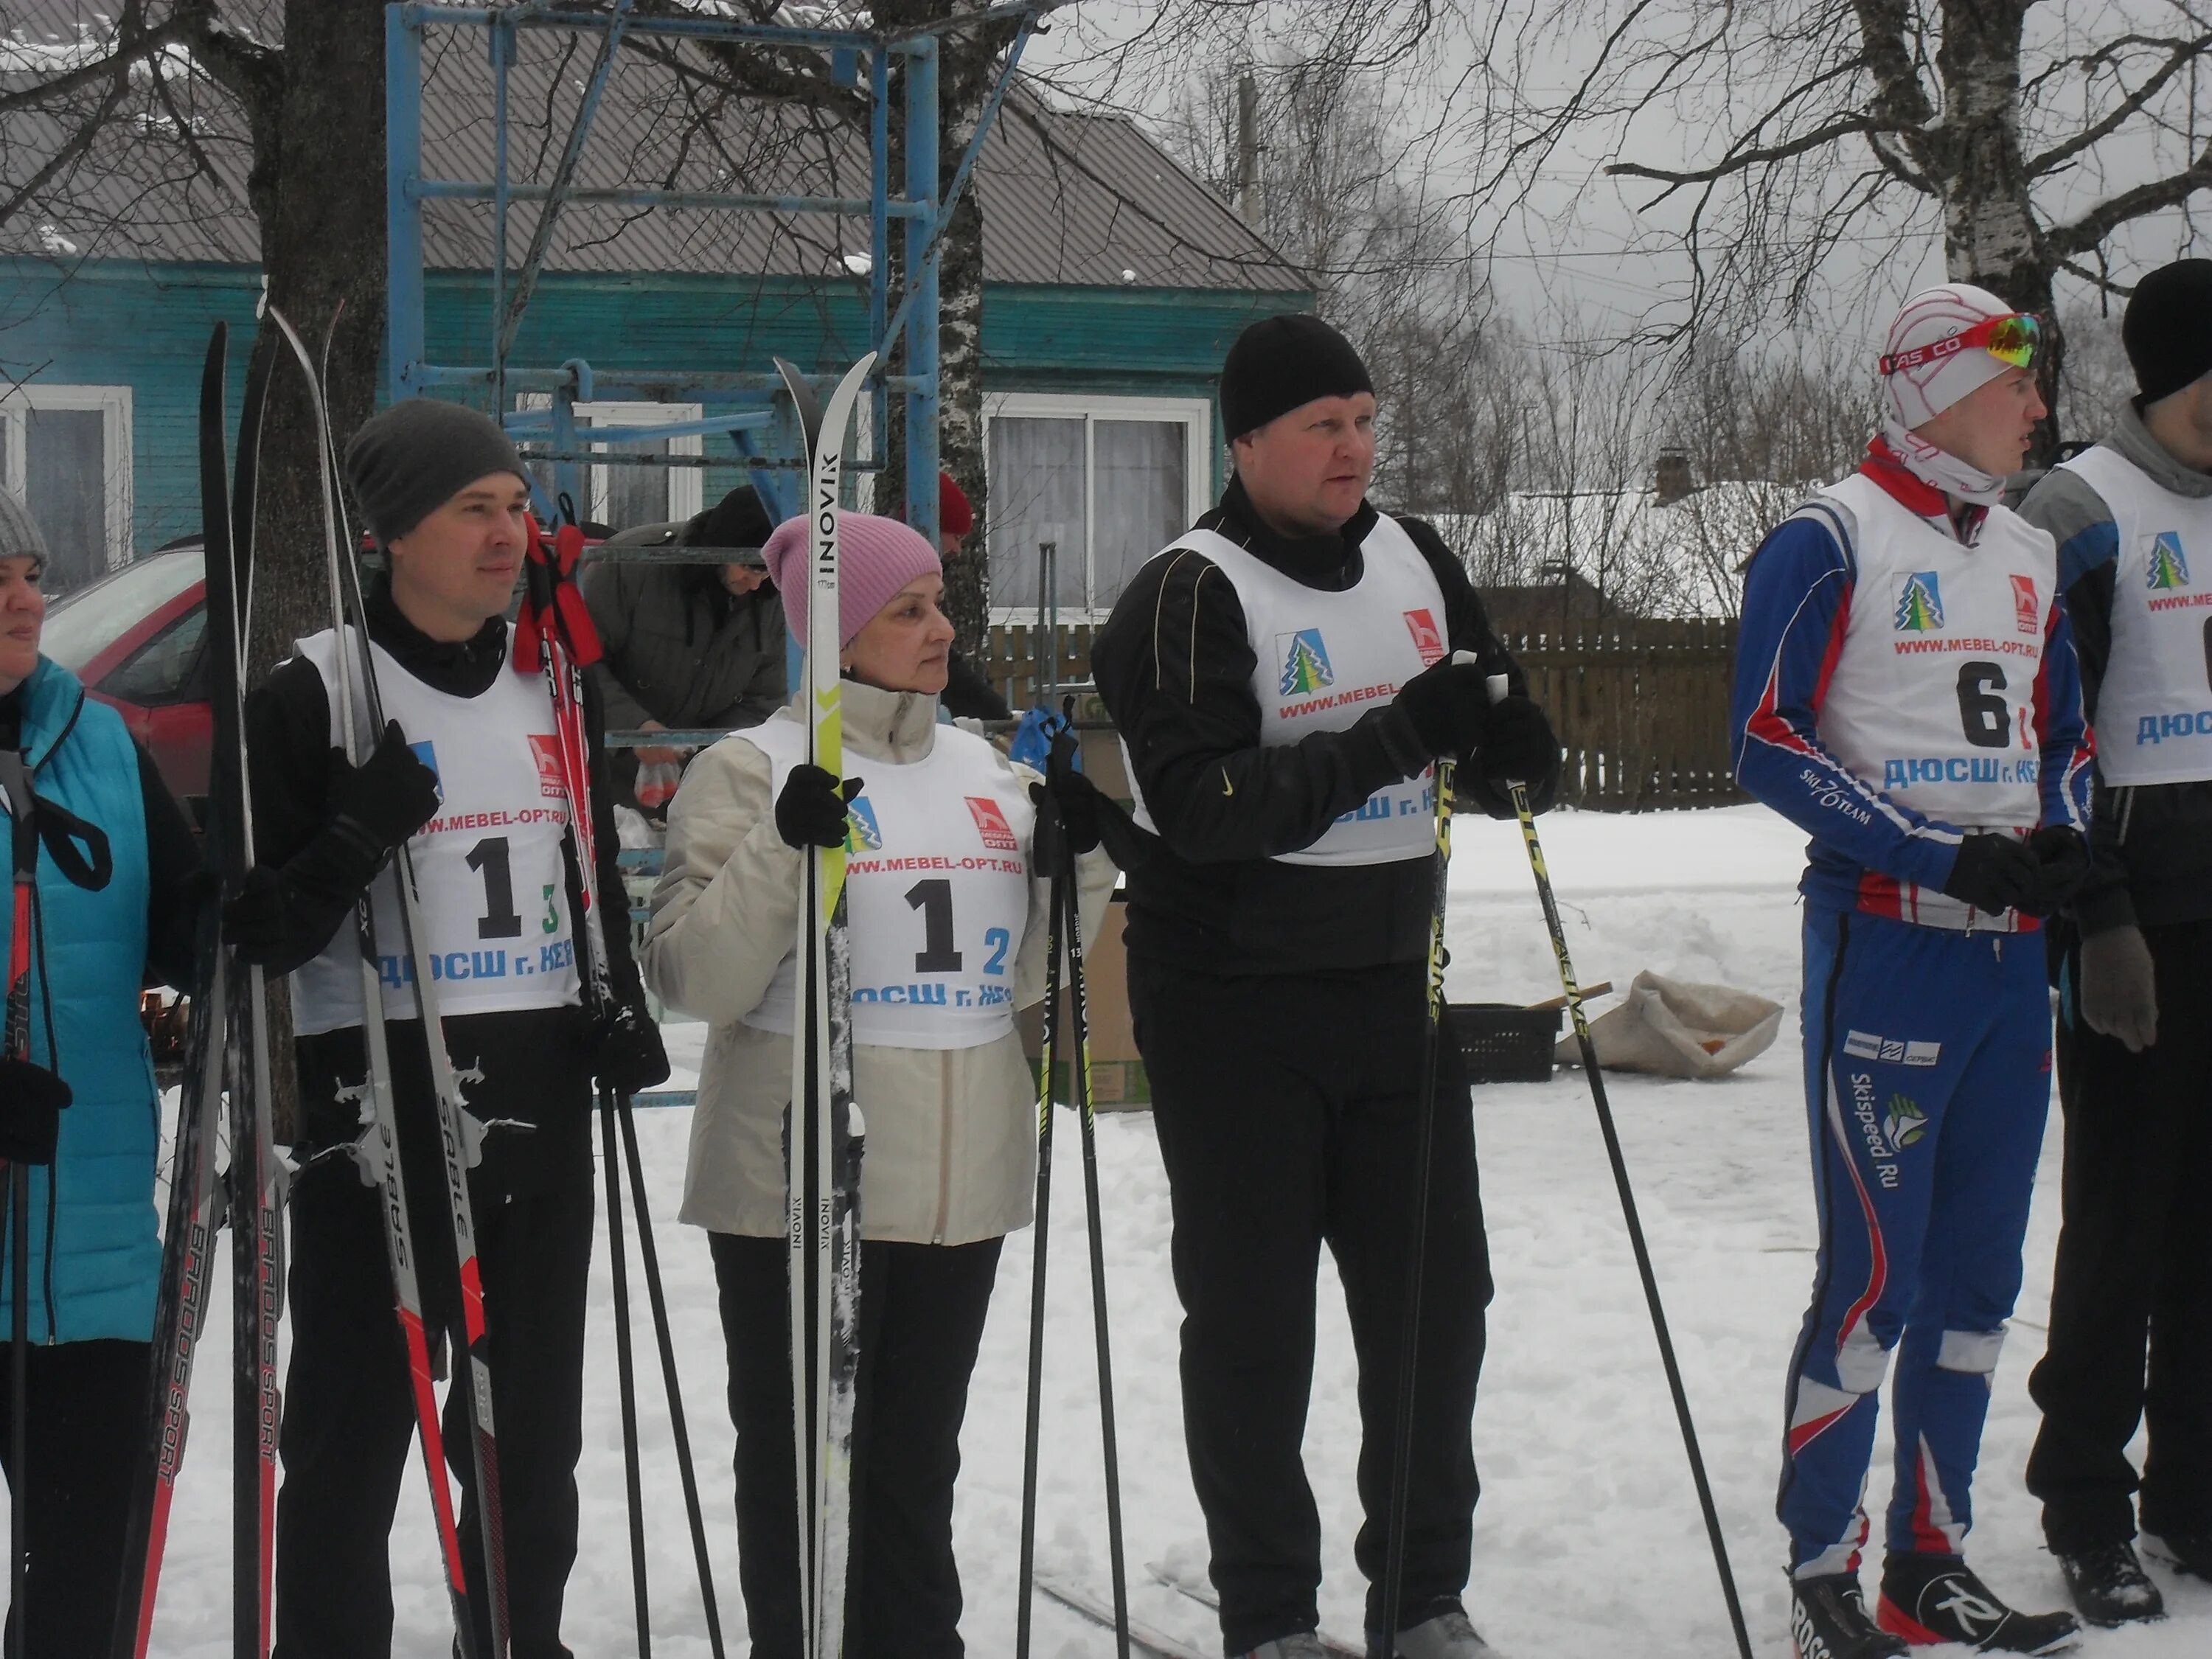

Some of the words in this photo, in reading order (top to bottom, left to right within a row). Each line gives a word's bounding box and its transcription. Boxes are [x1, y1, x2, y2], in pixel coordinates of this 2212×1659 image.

[819, 453, 838, 574] INOVIK
[1894, 639, 2039, 658] WWW.MEBEL-OPT.RU
[1279, 684, 1401, 720] WWW.MEBEL
[1956, 661, 2011, 748] 6
[1799, 769, 1822, 789] SKI
[1811, 780, 1850, 807] 76
[1837, 799, 1871, 825] TEAM
[1883, 758, 2000, 790] ДЮСШ
[2016, 759, 2039, 783] НЕ
[465, 837, 521, 939] 1
[542, 884, 559, 934] 3
[846, 857, 1022, 876] WW.MEBEL-OPT.RU
[904, 879, 962, 973] 1
[983, 927, 1010, 975] 2
[378, 1122, 408, 1270] SABLE
[442, 1096, 470, 1240] SABLE
[158, 1388, 184, 1487] SPORT
[260, 1369, 276, 1464] SPORT
